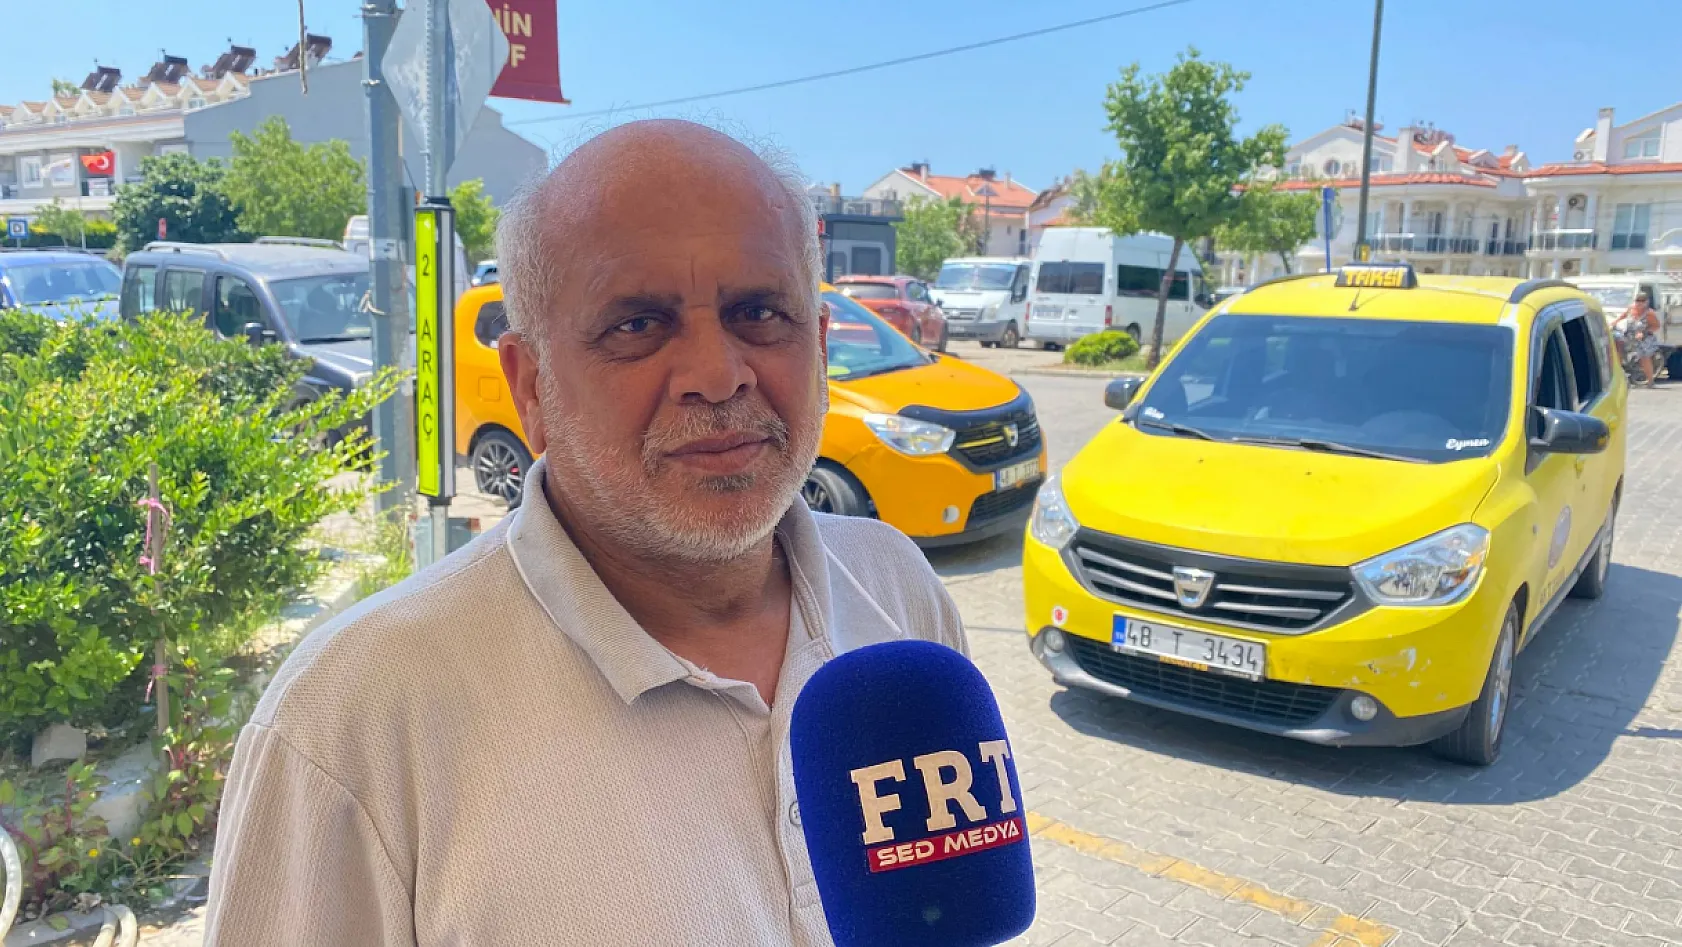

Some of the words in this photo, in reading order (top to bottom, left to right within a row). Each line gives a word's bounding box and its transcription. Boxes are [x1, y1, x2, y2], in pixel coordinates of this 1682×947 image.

[422, 254, 430, 276] 2
[420, 319, 433, 441] ARAÇ
[1128, 622, 1151, 648] 48
[1172, 631, 1184, 655] T
[1203, 638, 1257, 671] 3434
[850, 740, 1017, 845] FRT
[877, 841, 934, 867] SED
[944, 820, 1020, 854] MEDYA
